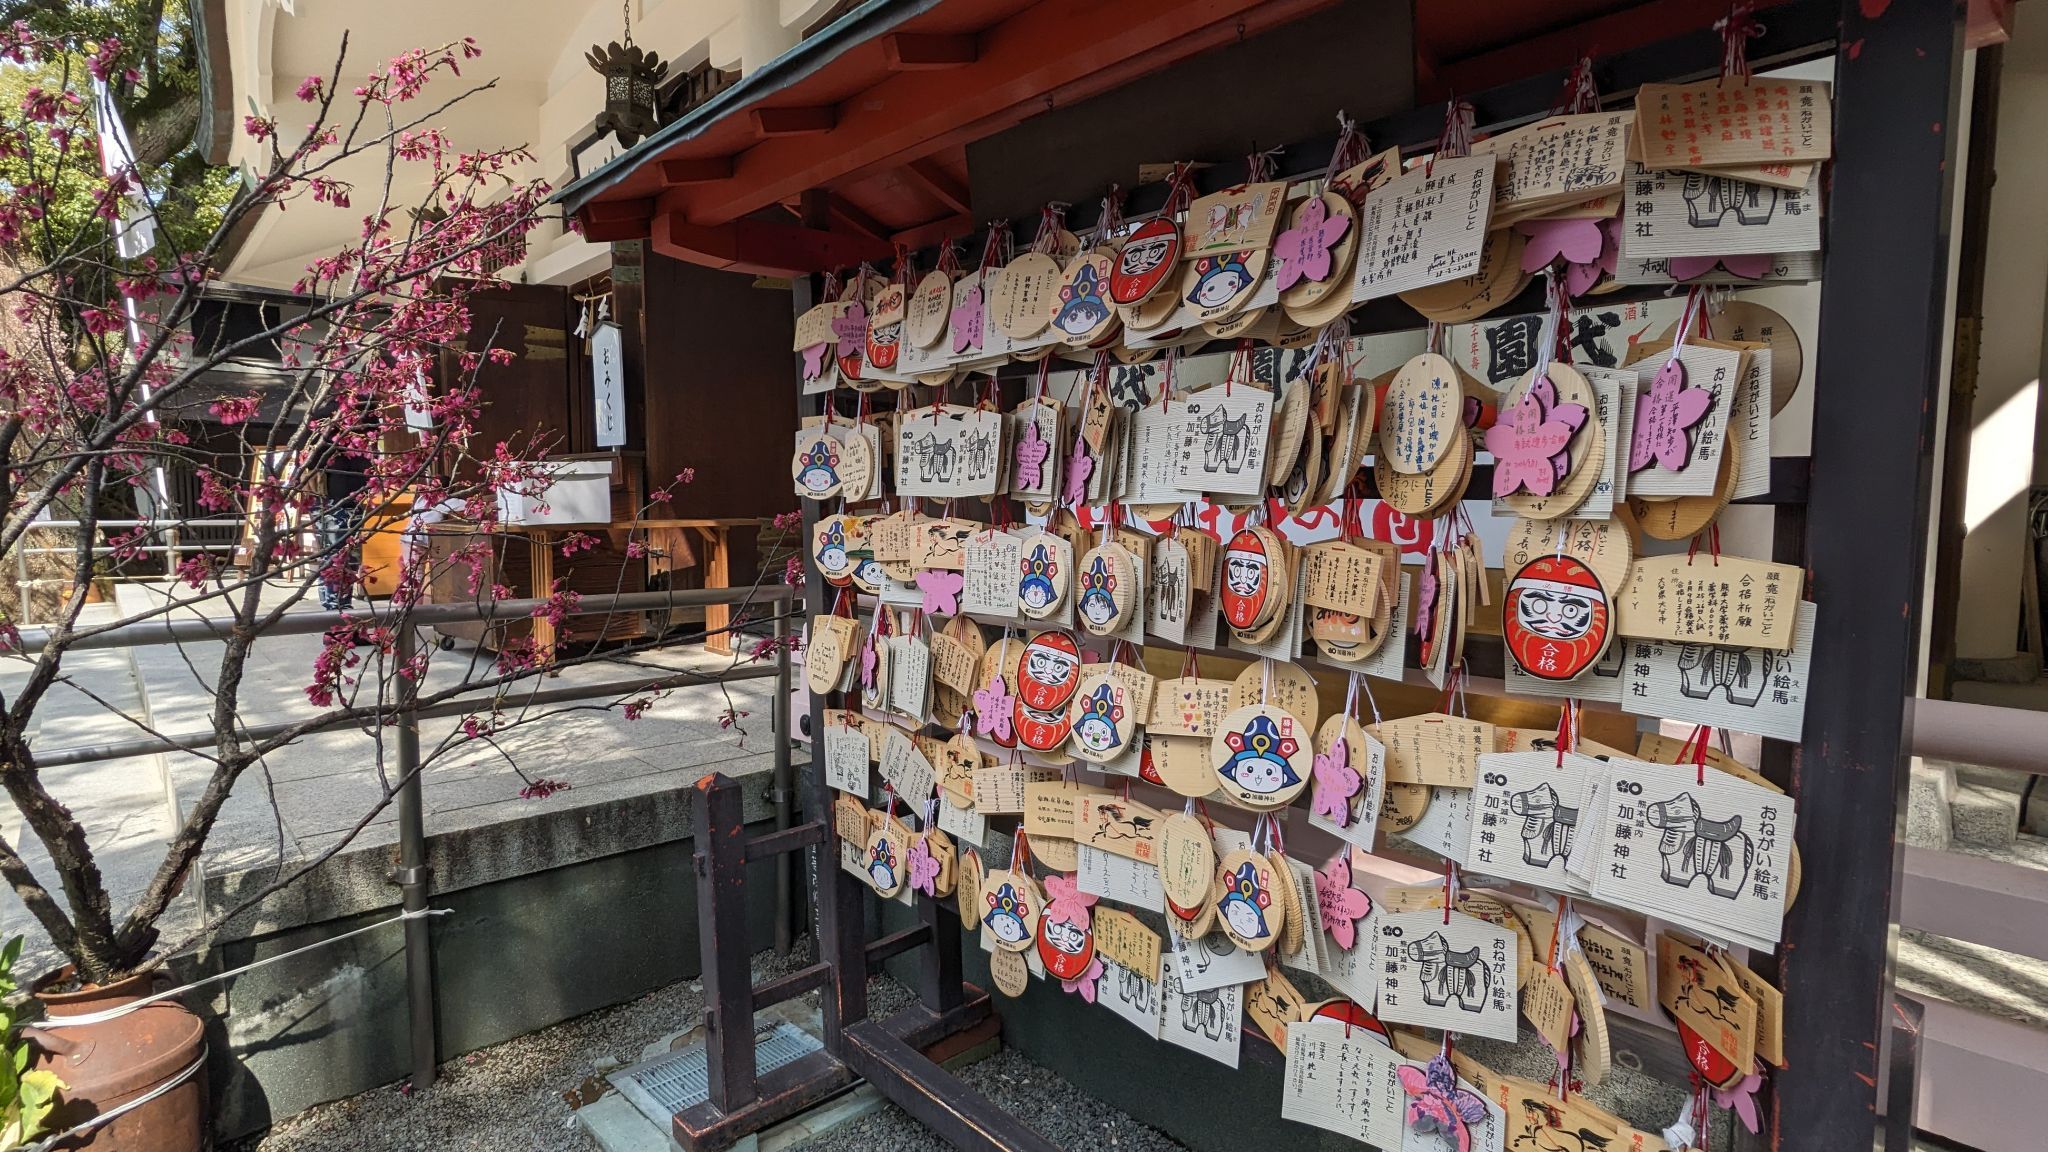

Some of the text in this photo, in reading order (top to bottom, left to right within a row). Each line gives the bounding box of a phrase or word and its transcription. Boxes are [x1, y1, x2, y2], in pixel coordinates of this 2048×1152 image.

[1466, 168, 1484, 231] おねがいごと
[1126, 277, 1141, 298] 合格
[1483, 315, 1543, 385] 園
[603, 347, 613, 432] おみくじ
[1749, 366, 1760, 441] おねがいごと
[1180, 422, 1195, 477] 加藤神社
[1235, 599, 1245, 622] 合格
[1537, 642, 1560, 672] 合格
[1033, 686, 1048, 705] 合格
[1031, 725, 1047, 744] 合格
[1251, 793, 1276, 803] 加藤神社
[1499, 790, 1512, 825] 熊本城内
[1634, 800, 1647, 839] 熊本城内
[1477, 793, 1500, 864] 加藤神社
[1610, 803, 1635, 880] 加藤神社
[1752, 805, 1778, 901] おねがい絵馬
[1054, 953, 1067, 974] 合格
[1384, 944, 1399, 1007] 加藤神社
[1492, 937, 1507, 1012] おねがい絵馬
[1386, 1061, 1398, 1114] おねがいごと
